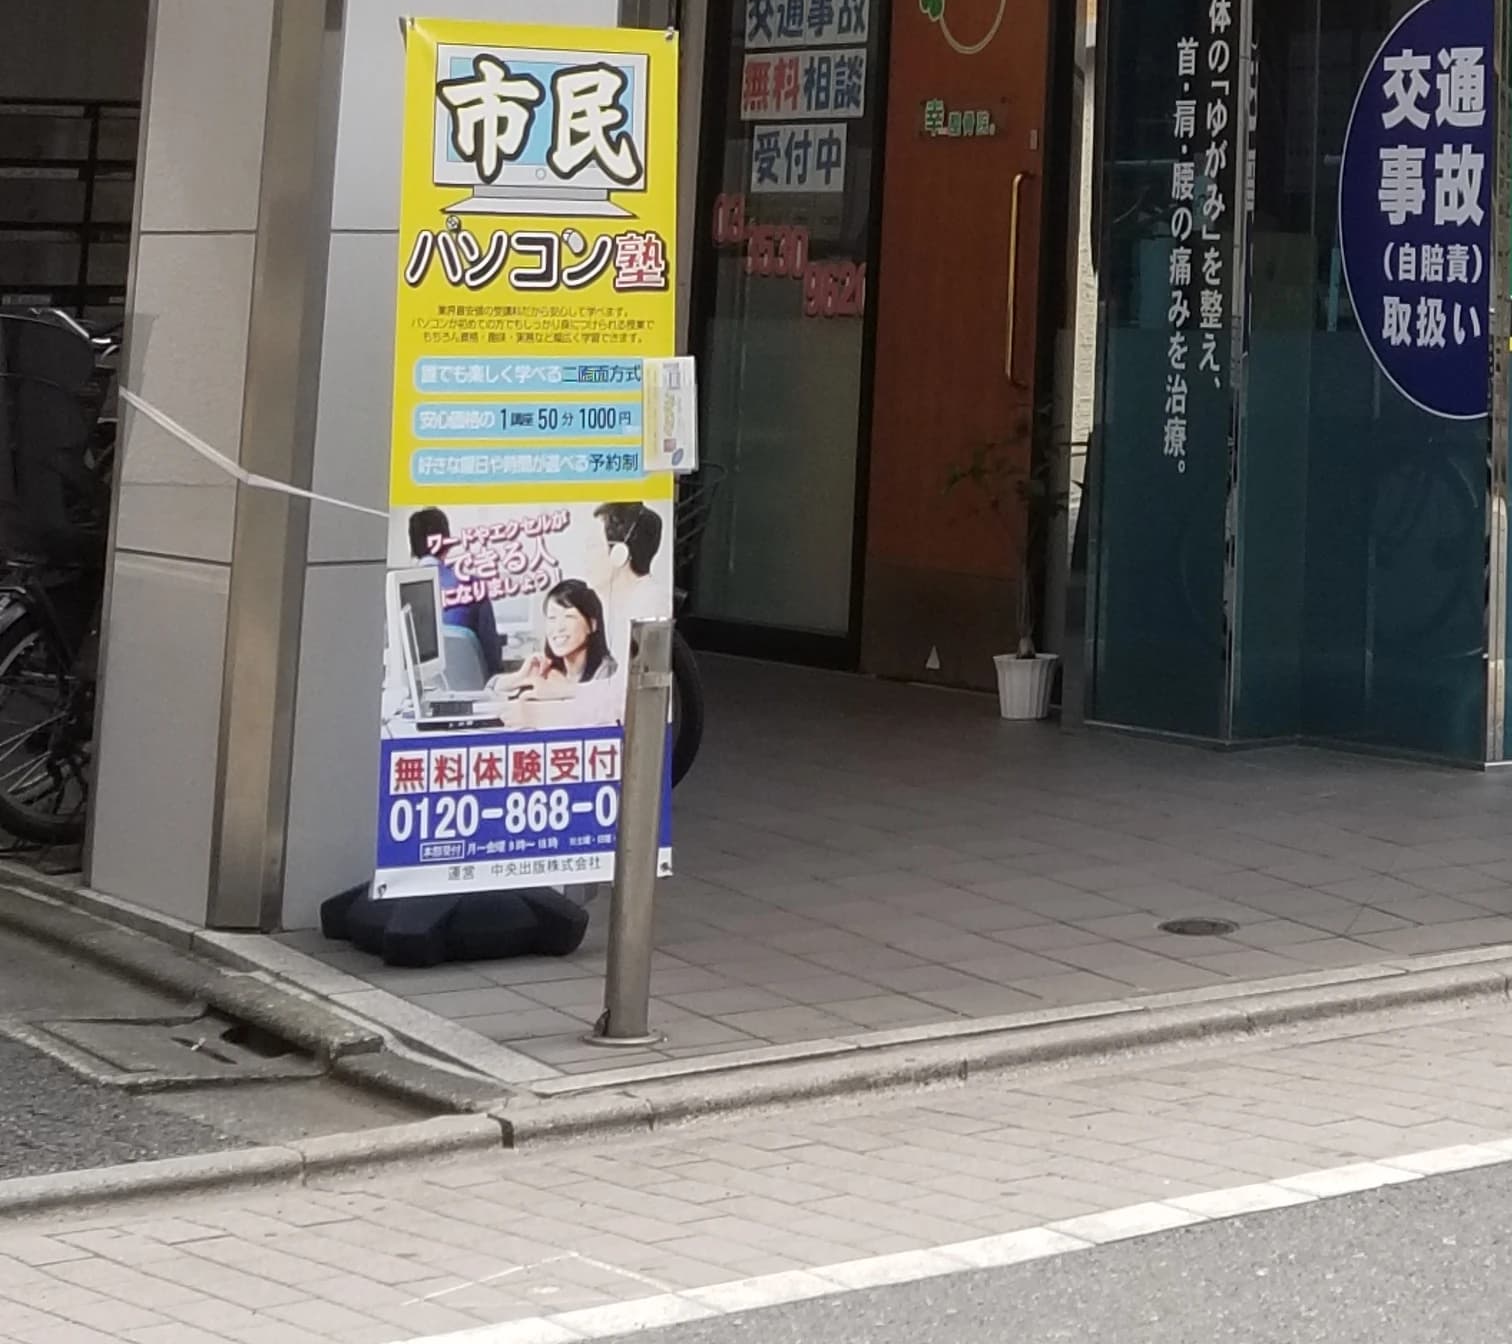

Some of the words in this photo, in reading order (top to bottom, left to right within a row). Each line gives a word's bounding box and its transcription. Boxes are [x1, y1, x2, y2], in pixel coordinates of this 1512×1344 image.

[743, 55, 865, 112] 無料相談
[1382, 47, 1486, 131] 交通
[437, 53, 643, 185] 市民
[754, 129, 842, 185] 受付中
[1379, 143, 1484, 226] 事故
[404, 216, 668, 292] パソコン塾
[1383, 295, 1481, 349] 取扱い
[394, 745, 619, 792] 無料体験受付
[389, 785, 619, 842] 0120-868-0
